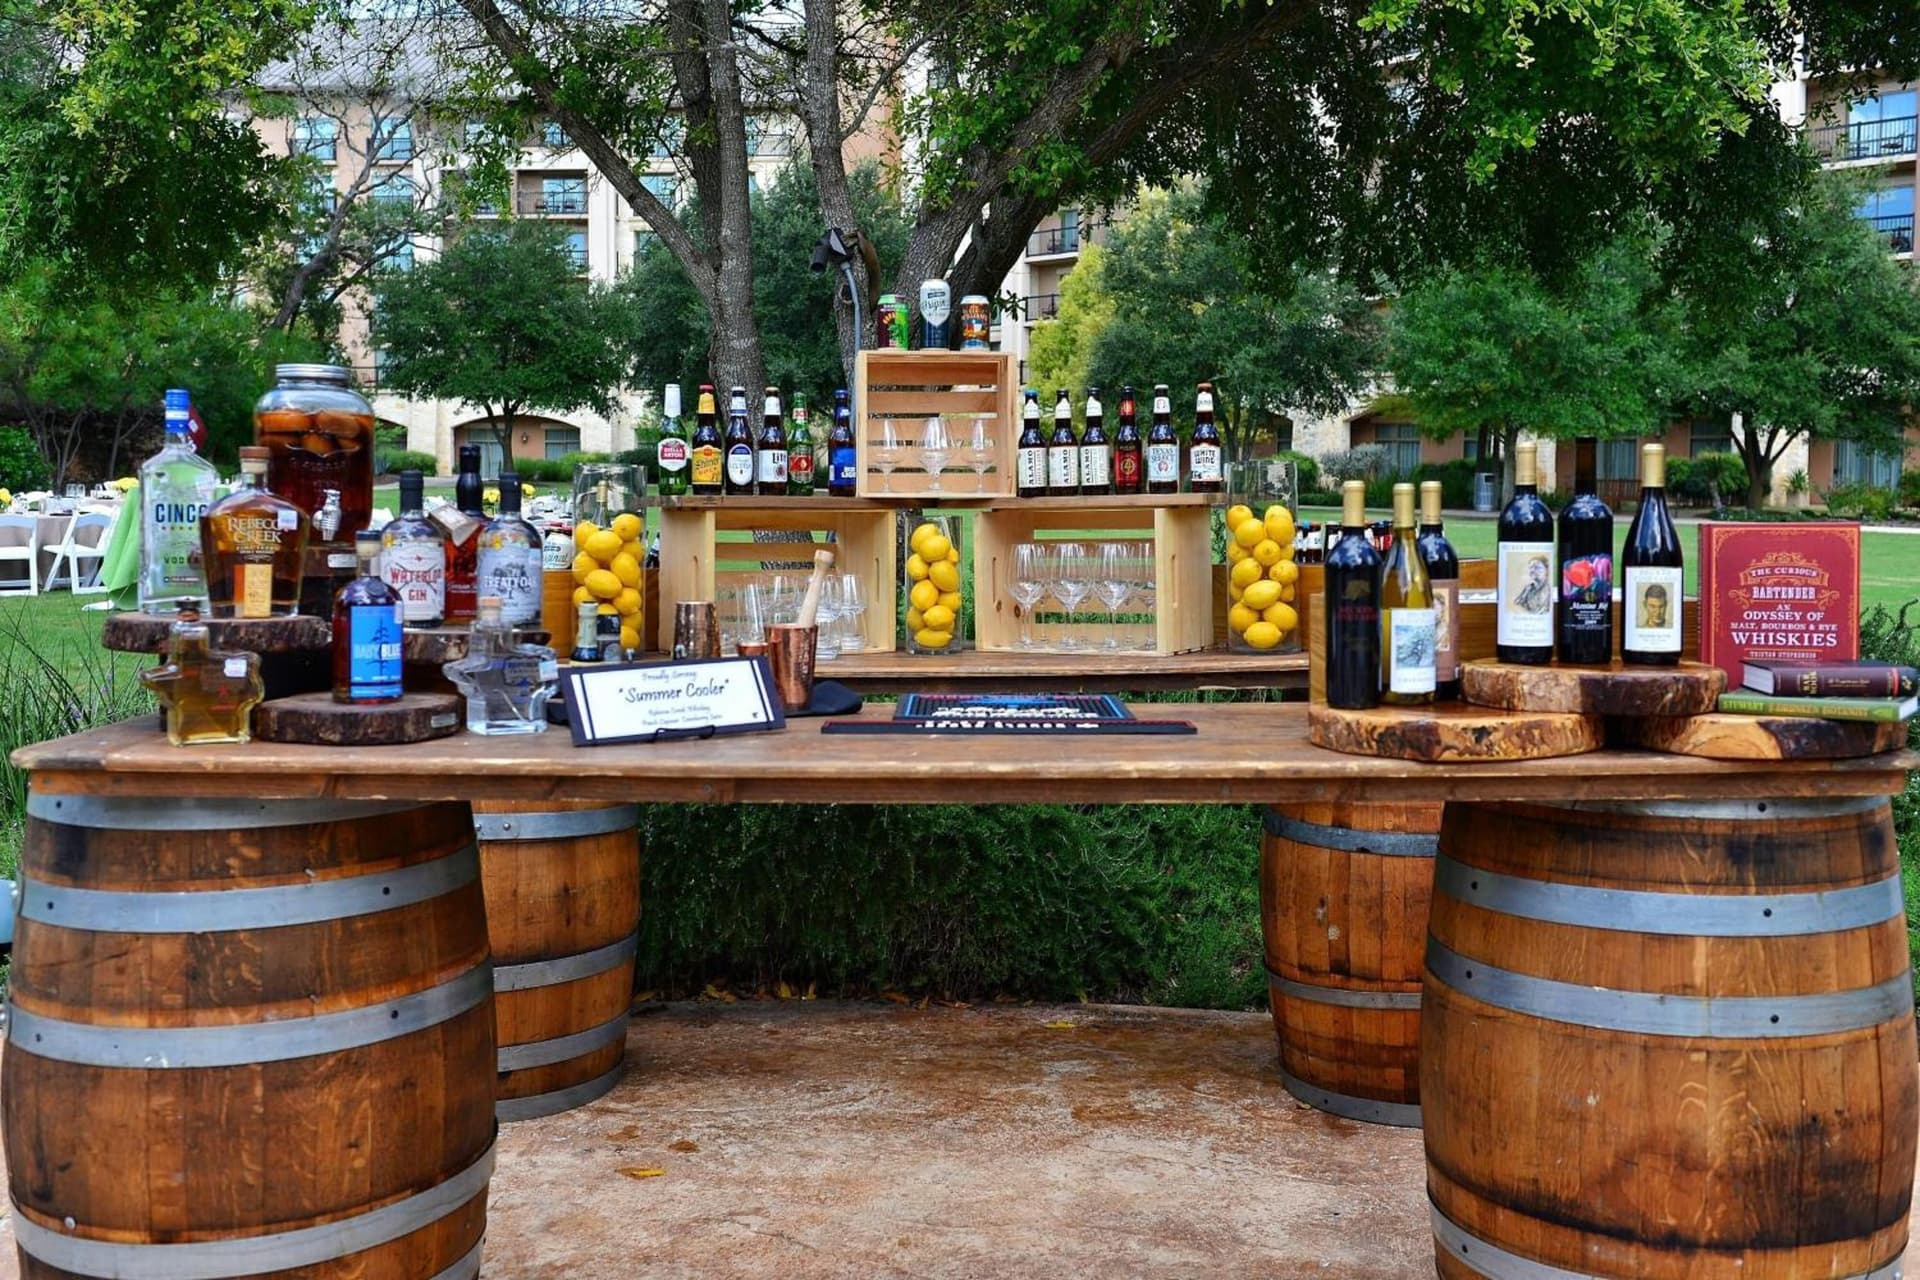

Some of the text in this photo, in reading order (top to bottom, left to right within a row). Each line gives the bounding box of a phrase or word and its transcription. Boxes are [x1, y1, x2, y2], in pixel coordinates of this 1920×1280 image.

[1194, 449, 1216, 457] WHITE
[1027, 450, 1035, 485] ALAMO
[1062, 449, 1070, 483] ALAMO
[1084, 448, 1092, 483] ALAMO
[233, 530, 283, 544] CREEK
[1751, 567, 1818, 577] THE CURIOUS
[483, 576, 519, 588] TREATY
[408, 589, 427, 601] GIN
[1752, 586, 1816, 599] BARTENDER
[1743, 611, 1825, 621] ODYSSEY OF
[1730, 622, 1838, 631] MALT, BOURBON & RYE
[1731, 632, 1838, 647] WHISKIES
[381, 642, 402, 661] BLUE
[1721, 700, 1764, 711] STEWART
